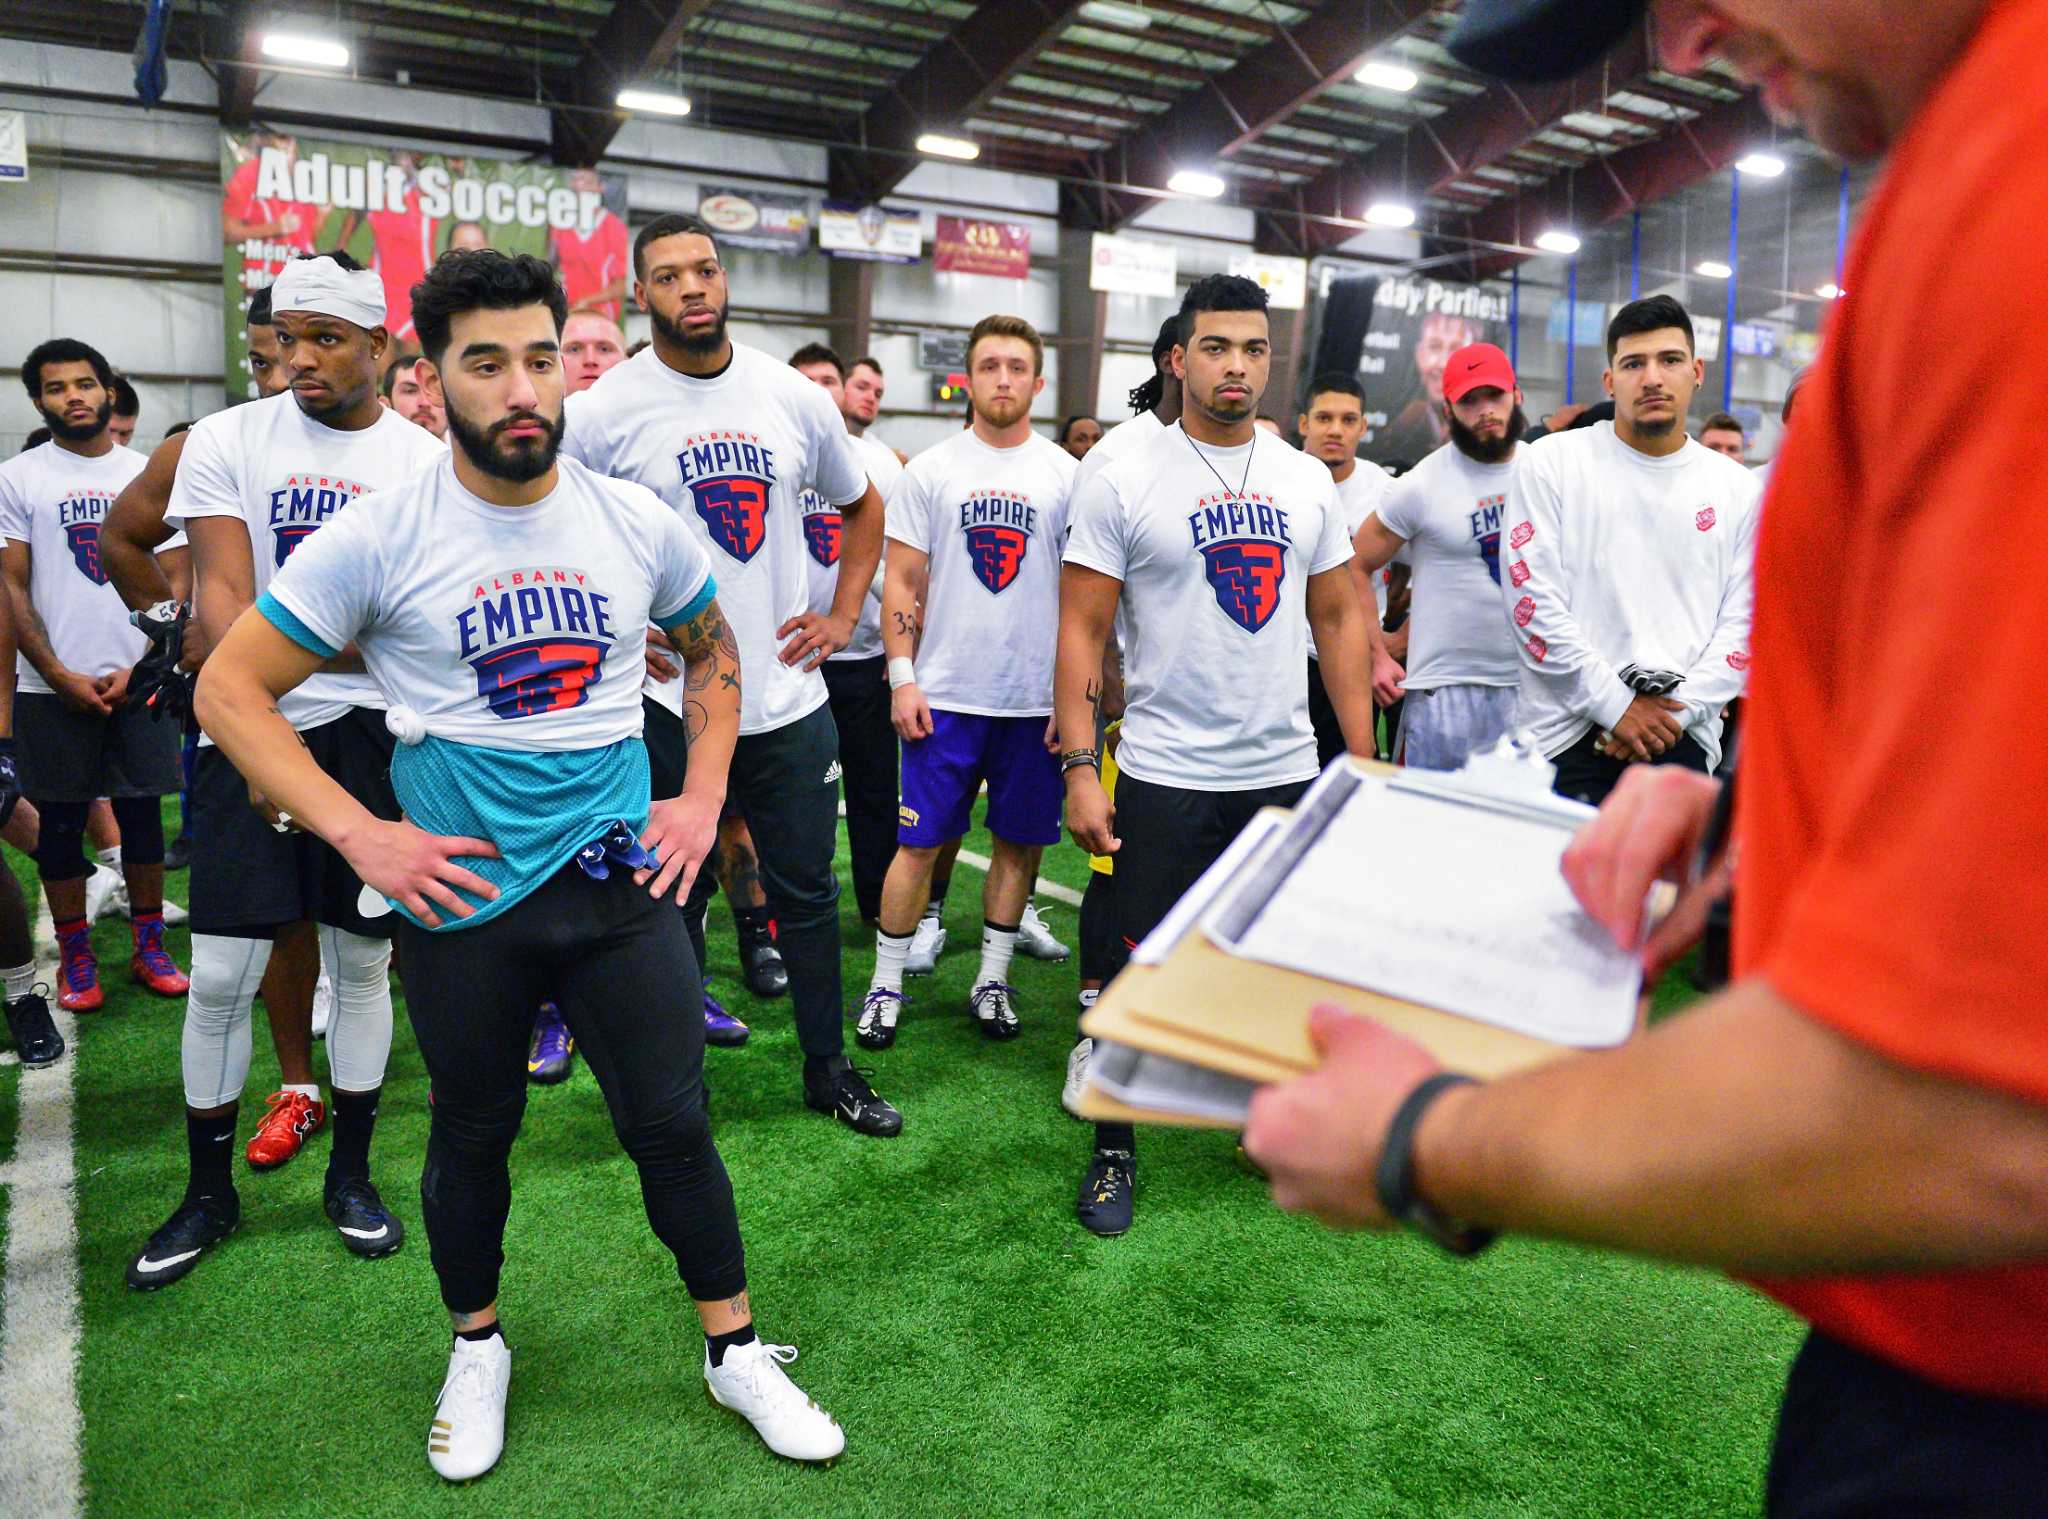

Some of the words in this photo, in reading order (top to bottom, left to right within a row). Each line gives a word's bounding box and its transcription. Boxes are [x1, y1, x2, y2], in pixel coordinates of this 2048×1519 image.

[256, 147, 408, 214] Adult
[418, 166, 601, 231] Soccer
[687, 432, 760, 446] ALBANY
[677, 442, 777, 484] EMPIRE
[288, 477, 372, 494] ALBAN
[970, 490, 1028, 502] ALBANY
[1198, 491, 1274, 507] ALBANY
[58, 497, 114, 525] EMPI
[960, 498, 1037, 534] EMPIRE
[1188, 503, 1293, 548] EMPIRE
[474, 570, 585, 599] ALBANY
[456, 586, 618, 660] EMPIRE
